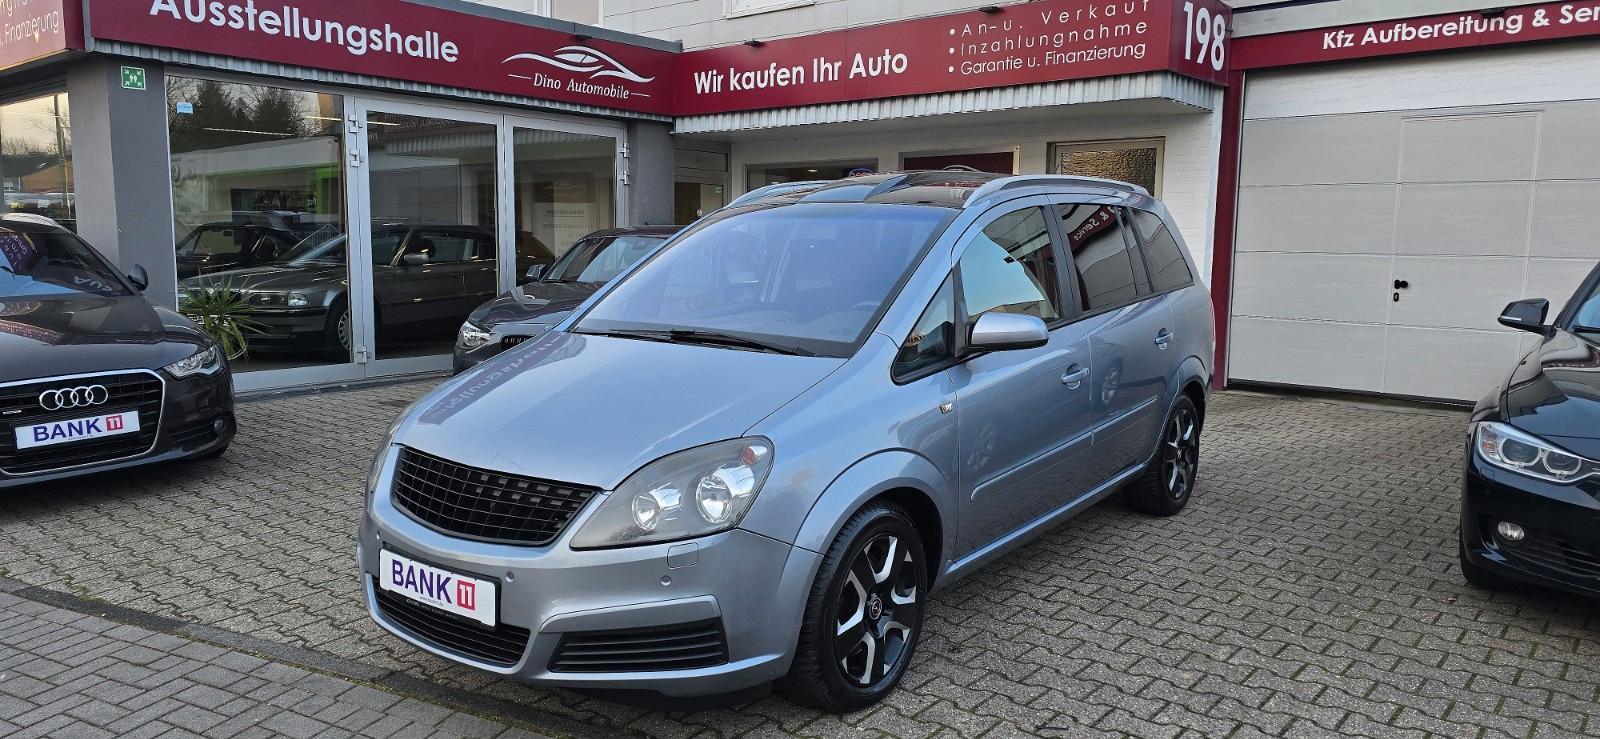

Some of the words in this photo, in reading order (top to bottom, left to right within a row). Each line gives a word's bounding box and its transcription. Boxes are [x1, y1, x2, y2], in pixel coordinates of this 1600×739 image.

[5, 10, 59, 44] Finanzierung
[150, 0, 460, 63] Ausstellungshalle
[961, 21, 1148, 56] Inzahlungnahme
[1183, 1, 1226, 71] 198
[1322, 31, 1354, 49] Kfz
[1361, 14, 1524, 46] Aufbereitung
[1531, 8, 1550, 26] &
[694, 70, 724, 95] Wir
[729, 61, 805, 91] kaufen
[812, 56, 841, 82] Ihr
[849, 49, 908, 79] Auto
[960, 56, 1023, 75] Garantie
[1028, 55, 1040, 68] u.
[1045, 43, 1146, 66] Finanzierung
[533, 72, 561, 91] Dino
[566, 78, 629, 99] Automobile
[33, 418, 102, 442] BANK
[392, 559, 452, 604] BANK
